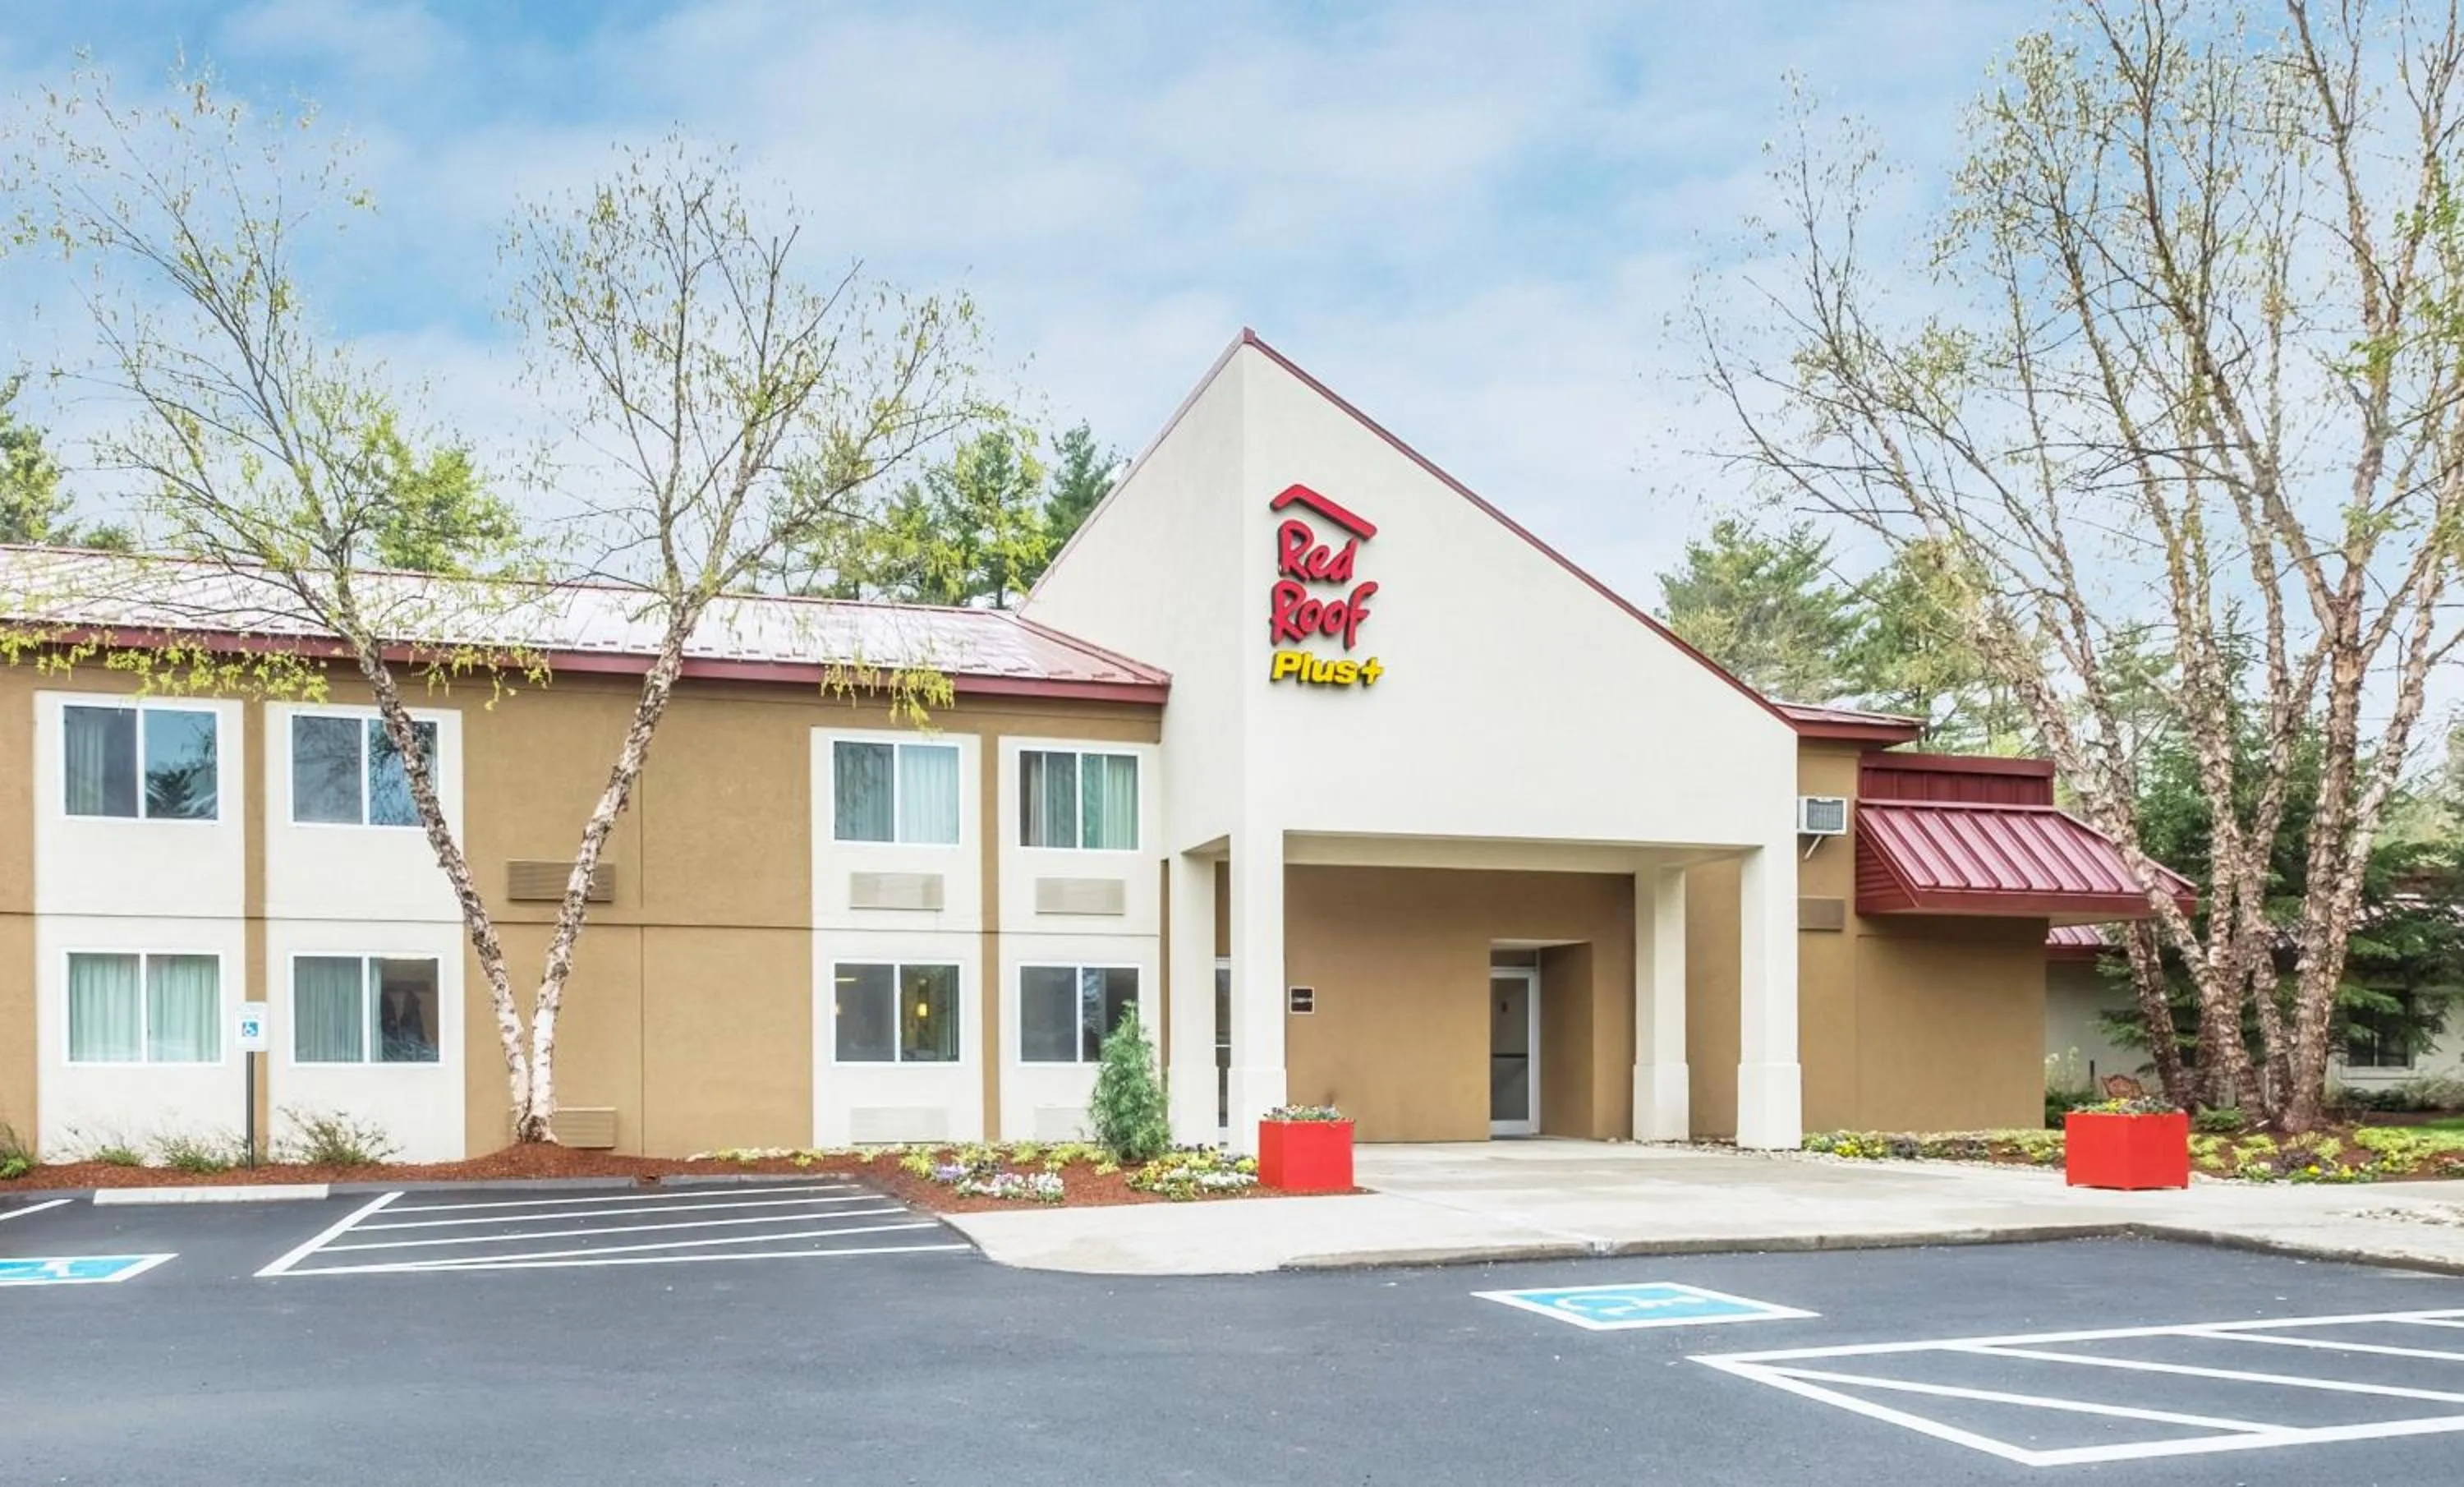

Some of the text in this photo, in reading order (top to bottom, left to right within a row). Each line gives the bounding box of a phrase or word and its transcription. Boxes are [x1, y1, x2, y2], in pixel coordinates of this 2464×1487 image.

[1277, 519, 1359, 582] Red
[1270, 578, 1379, 651] Roof
[1271, 650, 1384, 688] Plus+
